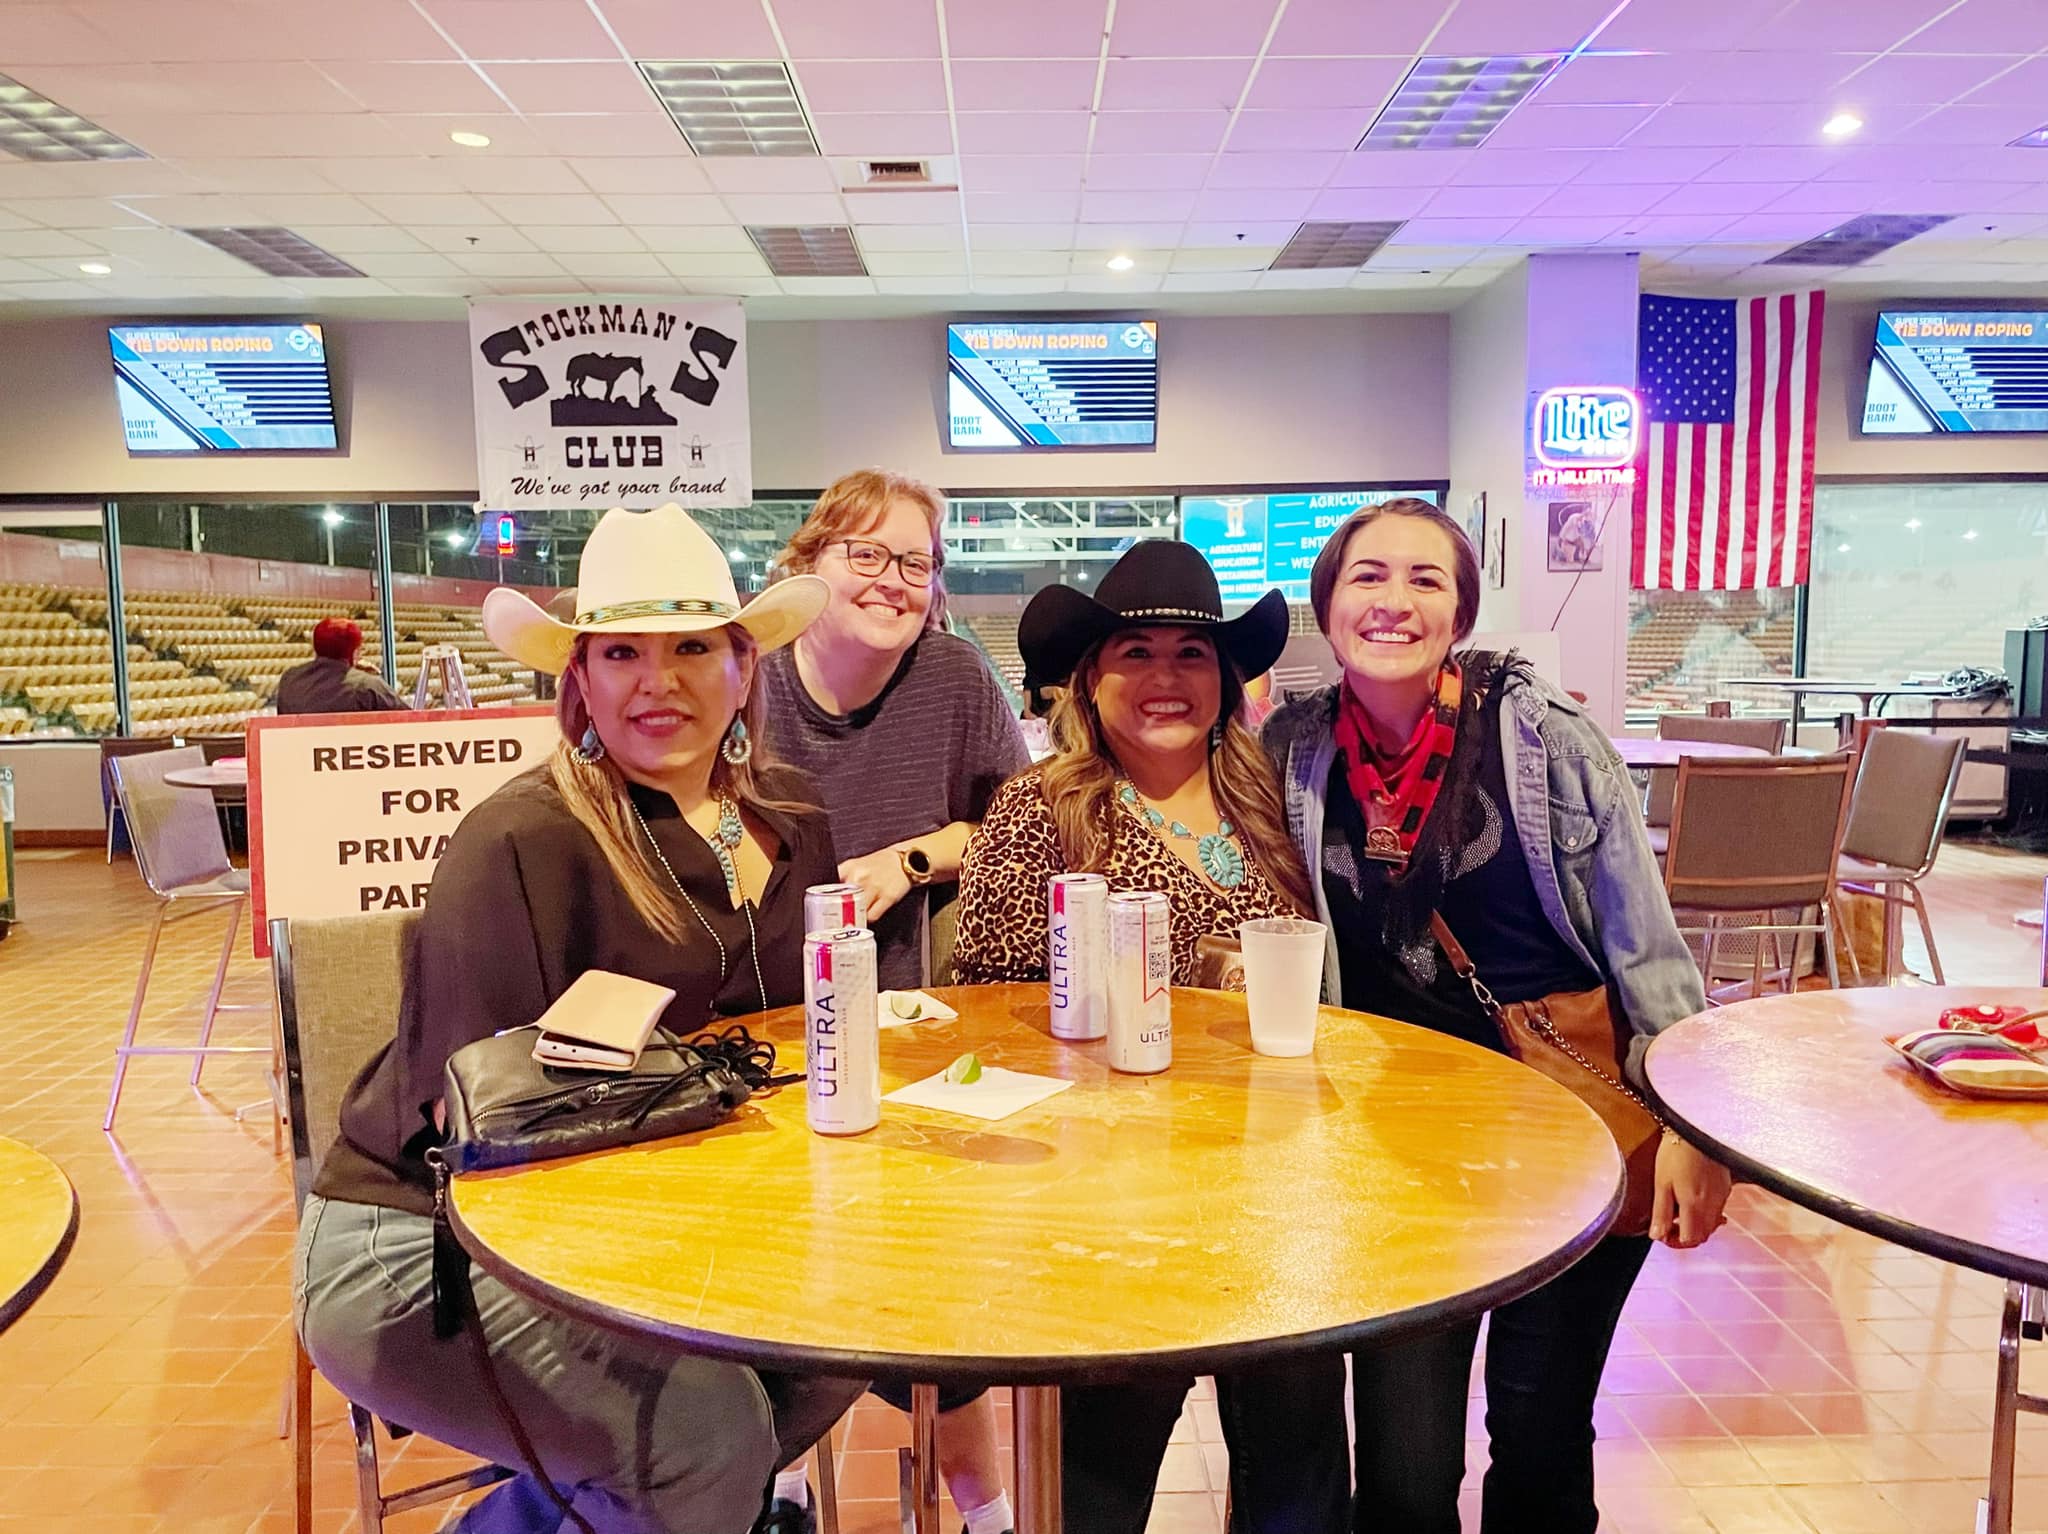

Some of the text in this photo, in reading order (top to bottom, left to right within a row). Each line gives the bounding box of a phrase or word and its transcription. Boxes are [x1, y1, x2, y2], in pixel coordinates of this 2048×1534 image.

[965, 335, 1108, 349] TIE DOWN ROPING
[1894, 323, 2033, 337] TIE DOWN ROPING
[126, 336, 273, 352] TIE DOWN ROPING
[480, 304, 737, 409] STOCKMAN'S
[953, 416, 982, 425] BOOT
[1867, 414, 1896, 422] BARN
[1868, 404, 1897, 412] BOOT
[127, 420, 155, 429] BOOT
[128, 430, 158, 439] BARN
[953, 426, 982, 435] BARN
[1543, 394, 1630, 452] Lite
[565, 436, 663, 468] CLUB
[511, 475, 727, 500] We've got your brand
[313, 739, 522, 772] RESERVED
[382, 788, 461, 815] FOR
[338, 835, 450, 865] PRIVA
[361, 883, 432, 911] PAR
[1054, 925, 1068, 1009] ULTRA
[816, 993, 838, 1097] ULTRA
